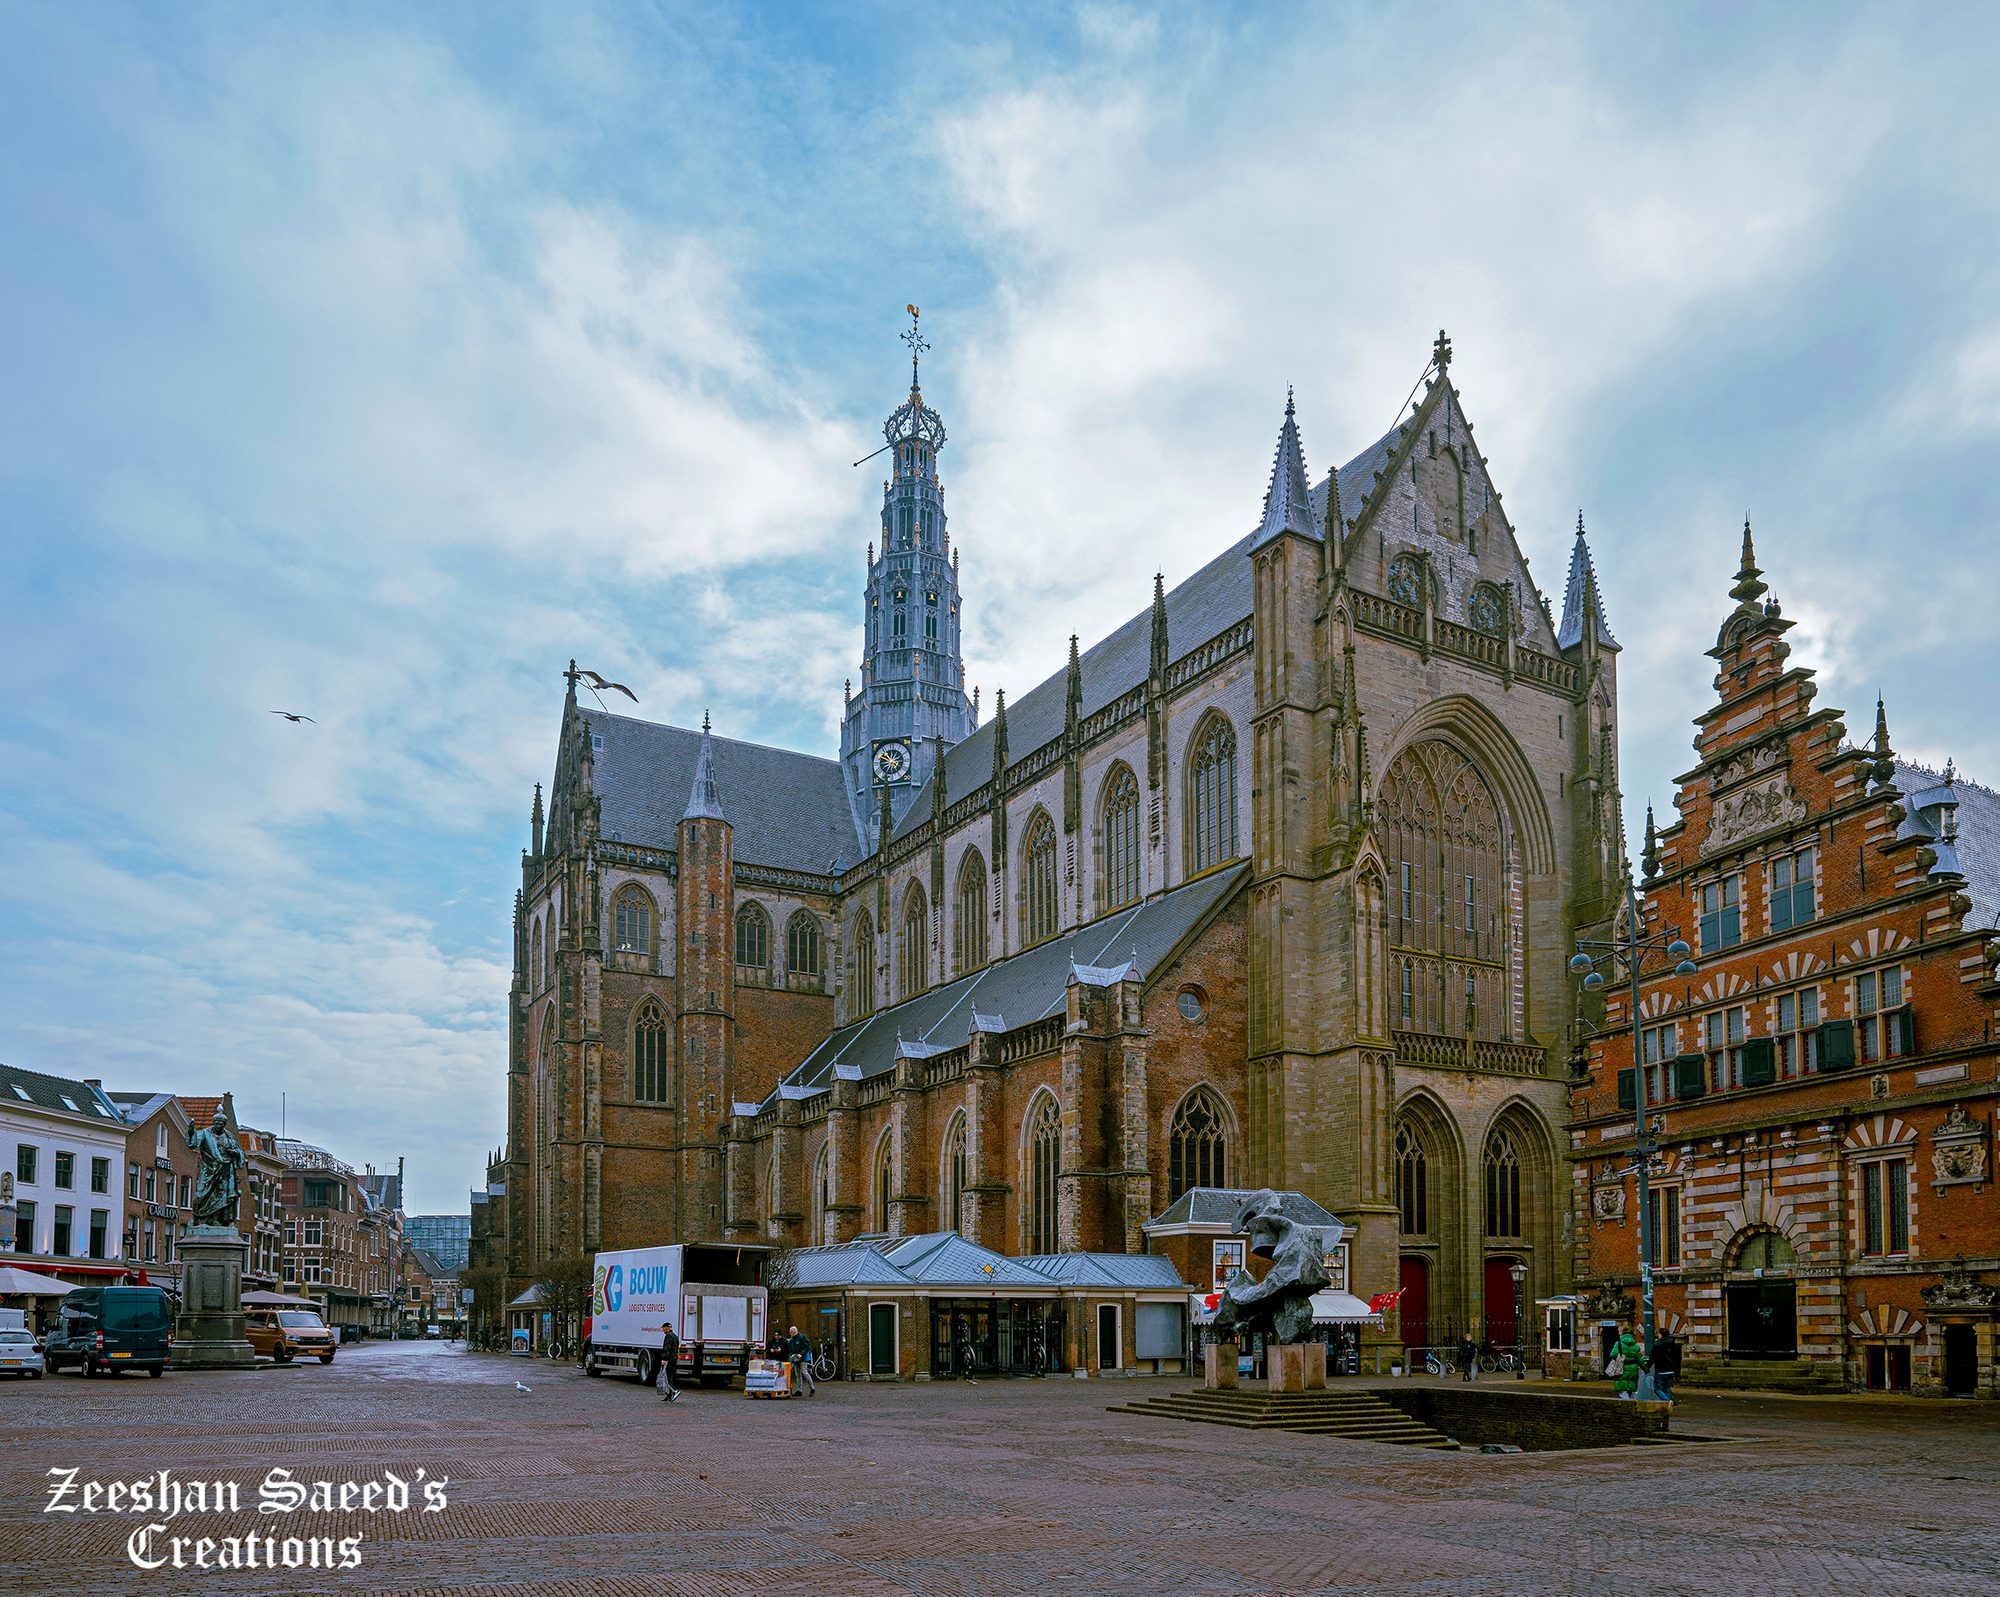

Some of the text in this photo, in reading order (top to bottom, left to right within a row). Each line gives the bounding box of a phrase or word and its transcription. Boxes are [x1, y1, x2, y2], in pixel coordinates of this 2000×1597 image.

[156, 1158, 173, 1170] HOTEL
[149, 1204, 179, 1219] CARILLON
[630, 1266, 668, 1296] BOUW
[628, 1303, 666, 1313] LOGISTIC SERVICES
